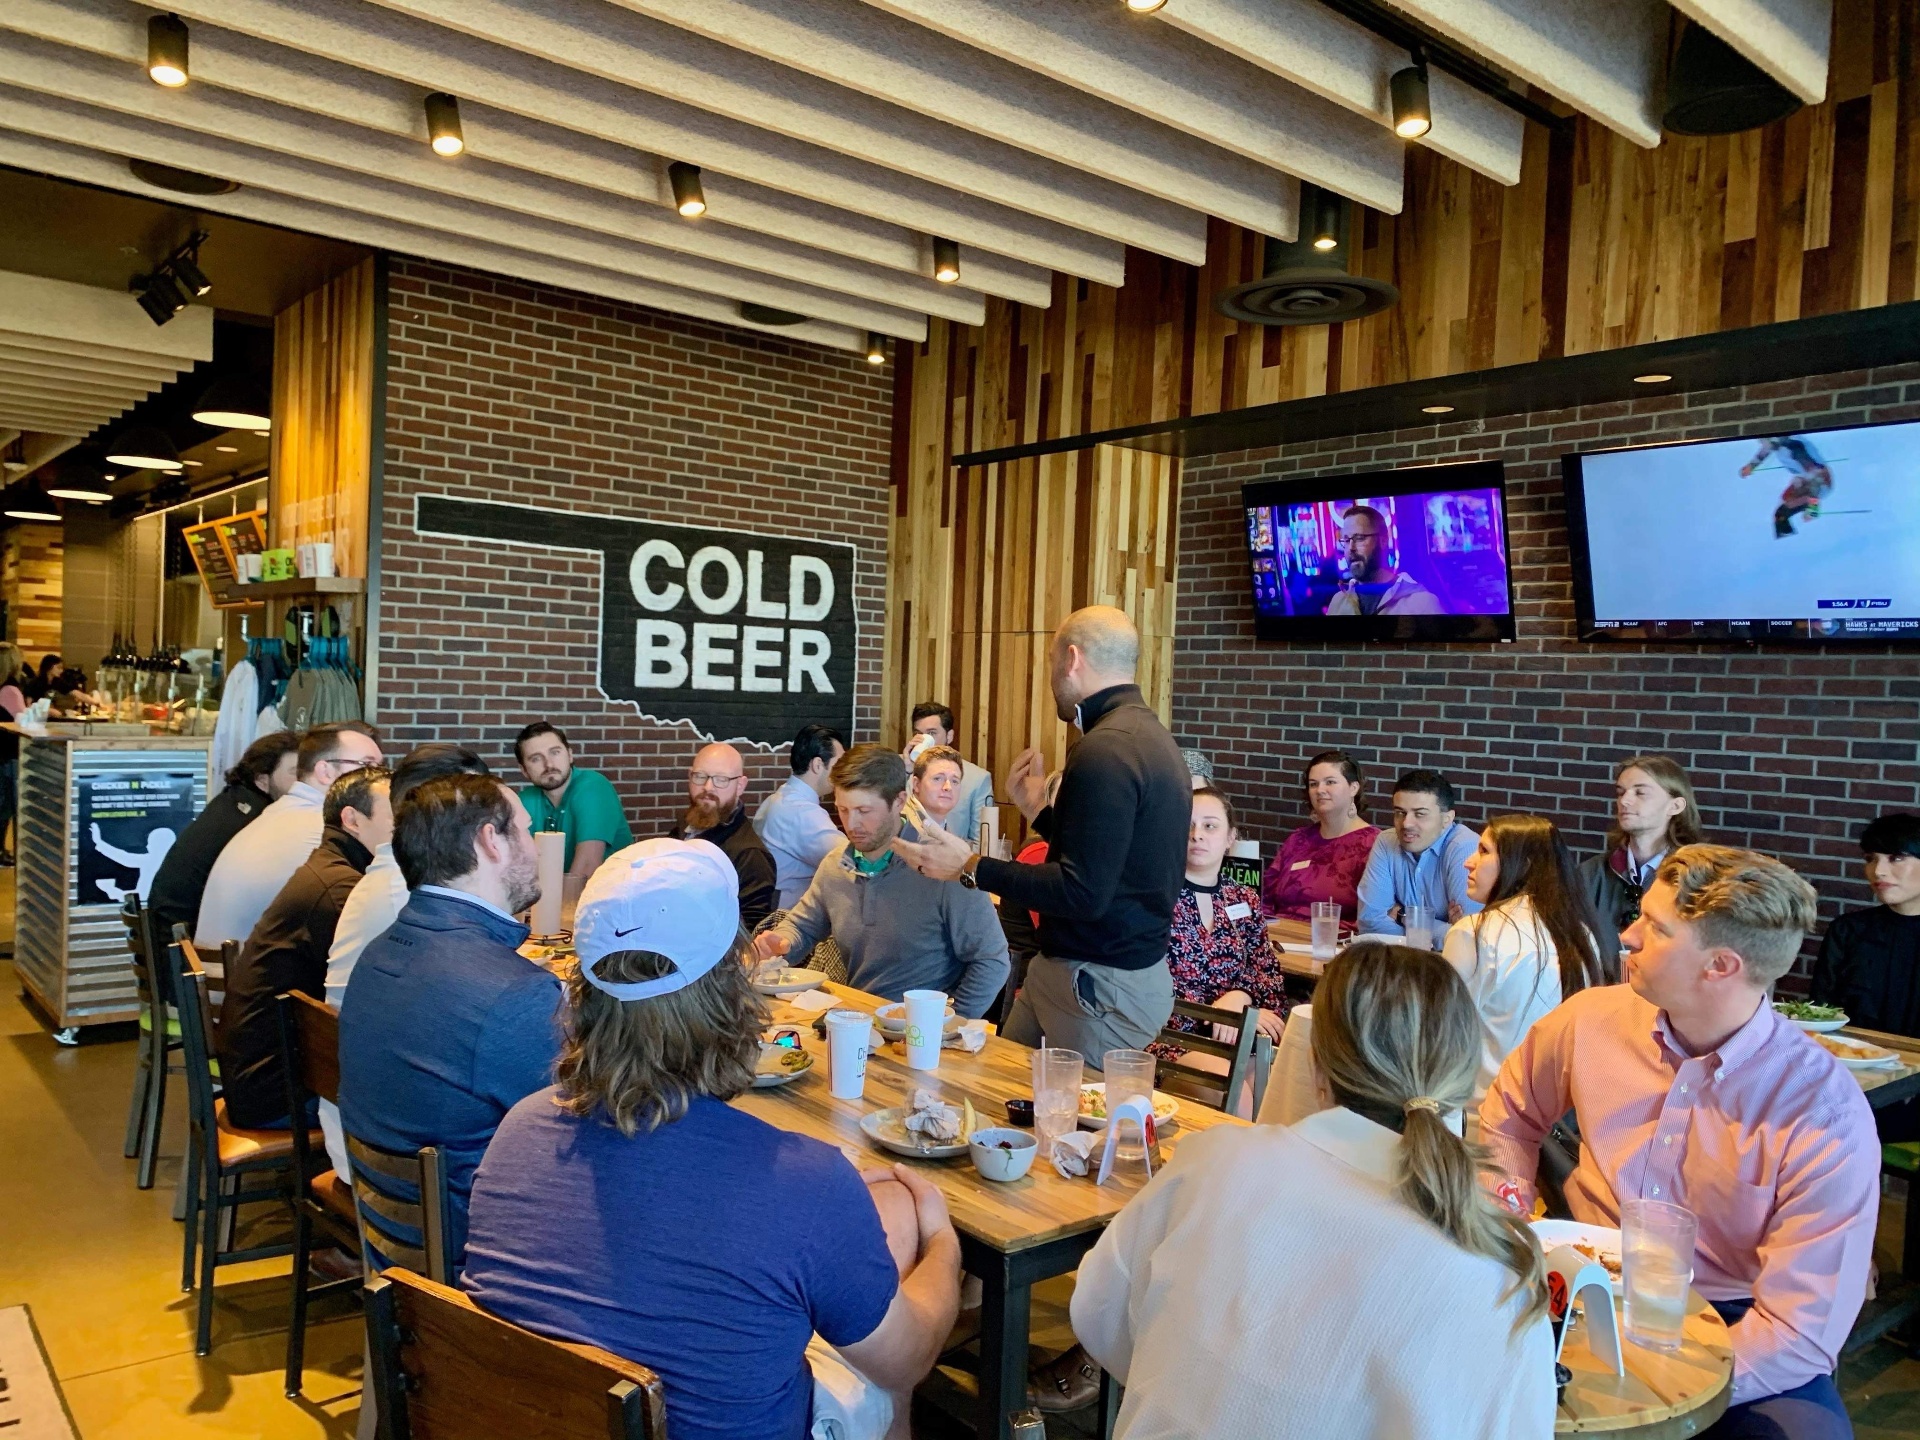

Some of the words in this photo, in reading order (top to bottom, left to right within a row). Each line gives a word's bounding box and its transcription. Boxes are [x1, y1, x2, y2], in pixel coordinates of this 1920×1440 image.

[629, 539, 835, 622] COLD
[1878, 620, 1919, 628] MAVERICKS
[634, 618, 836, 694] BEER
[91, 781, 130, 790] CHICKEN
[131, 781, 139, 789] N
[140, 780, 171, 789] PICKLE
